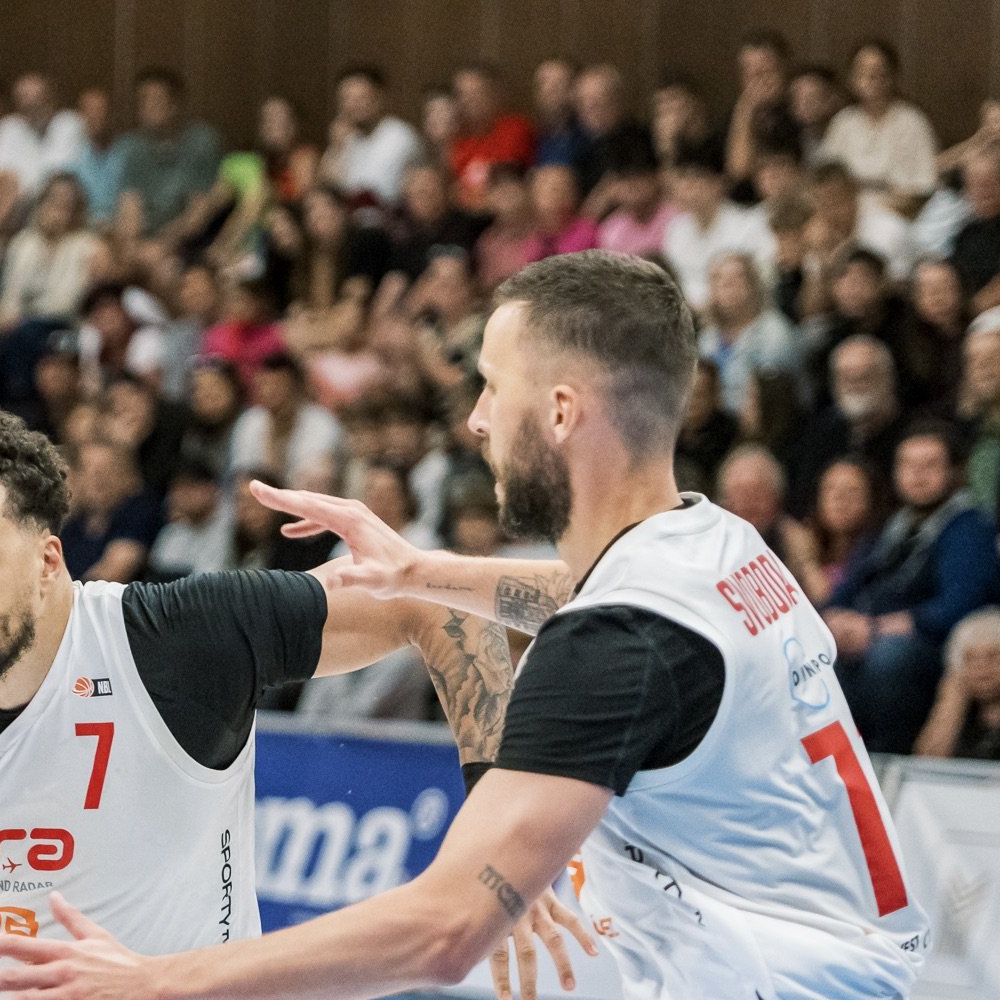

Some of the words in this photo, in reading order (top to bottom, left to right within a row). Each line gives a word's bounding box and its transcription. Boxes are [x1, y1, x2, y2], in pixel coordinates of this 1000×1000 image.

[97, 680, 112, 695] NBL
[74, 721, 115, 810] 7
[12, 880, 54, 893] RADAR
